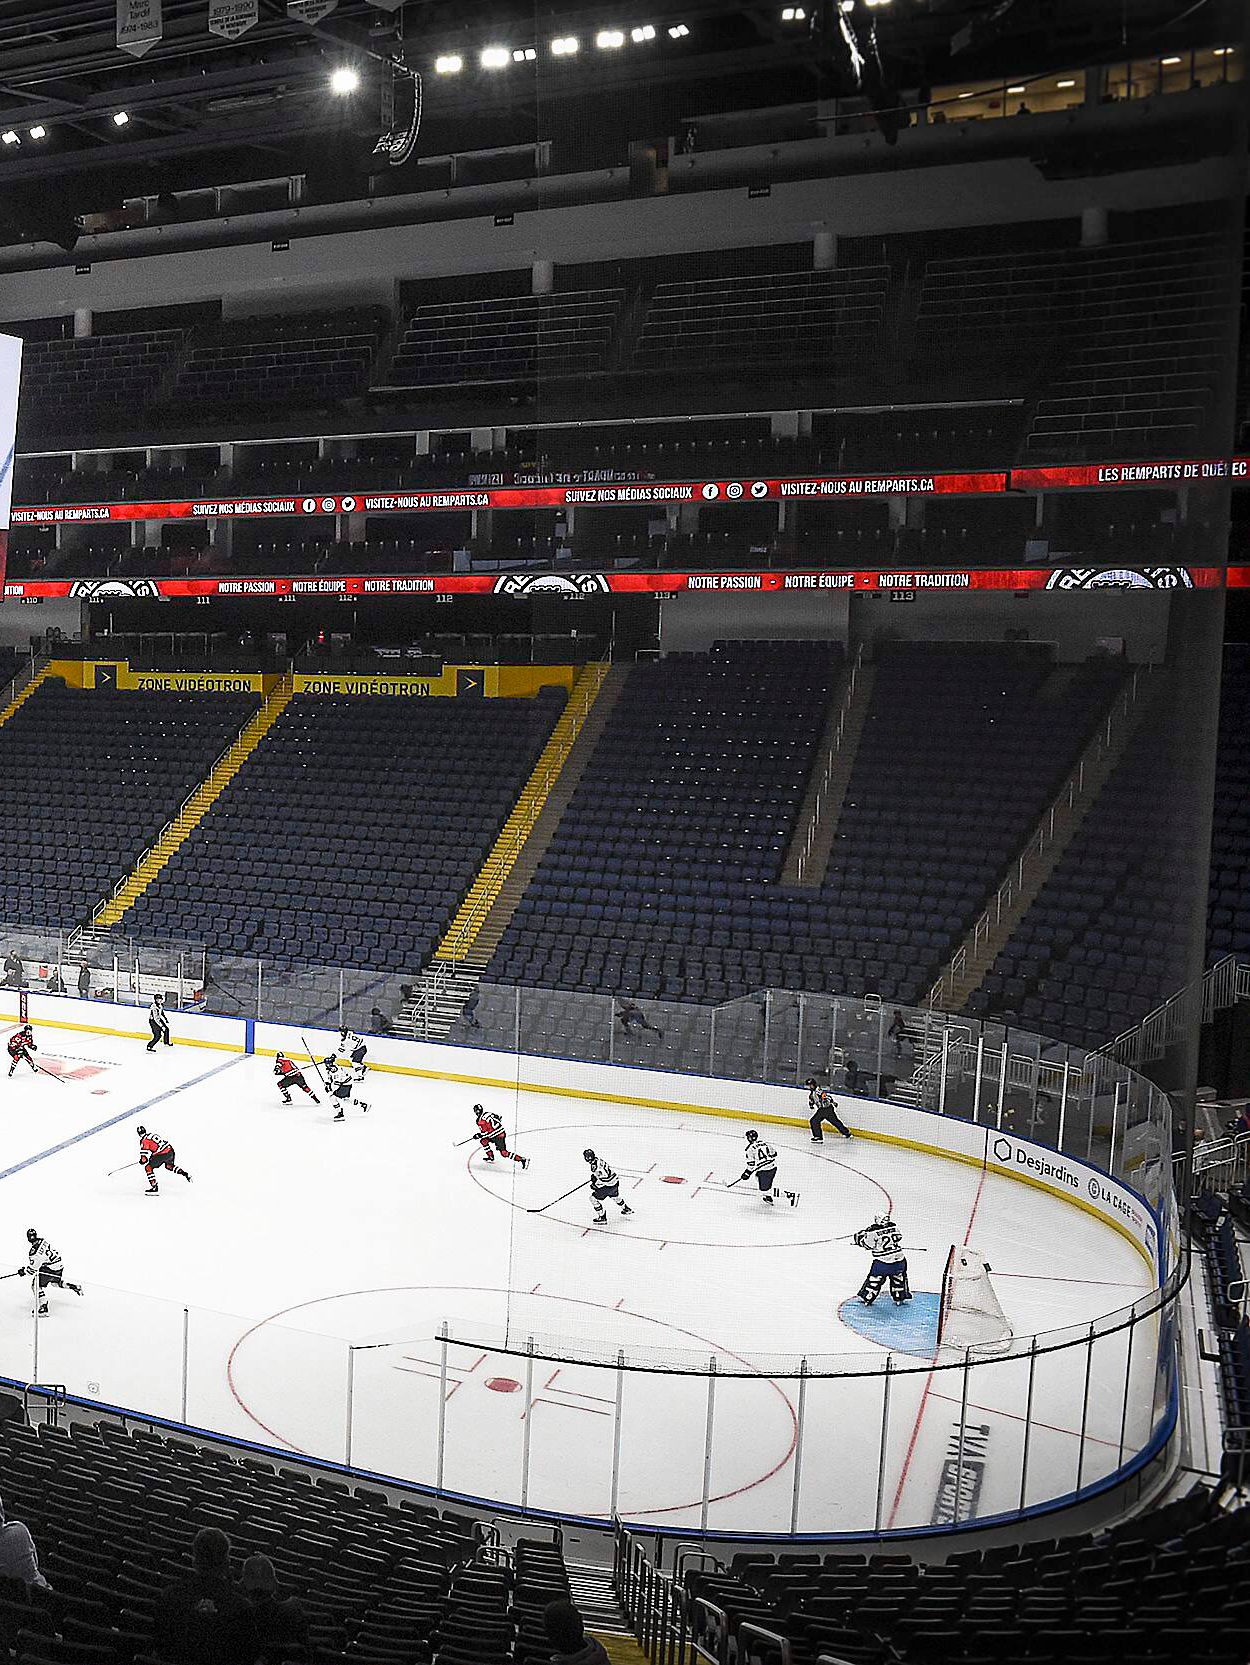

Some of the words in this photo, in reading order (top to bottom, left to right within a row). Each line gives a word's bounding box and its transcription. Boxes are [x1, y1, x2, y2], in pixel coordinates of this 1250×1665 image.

[1098, 468, 1119, 482] LES
[1121, 465, 1181, 481] REMPARTS
[1183, 464, 1199, 478] DE
[780, 481, 847, 495] VISITEZ-NOUS
[848, 480, 862, 493] AU
[864, 478, 934, 492] REMPARTS.CA
[565, 489, 597, 502] SUIVEZ
[597, 488, 616, 501] NOS
[617, 486, 651, 500] MÉDIAS
[652, 486, 692, 500] SOCIAUX
[192, 504, 218, 515] SUIVEZ
[218, 503, 233, 514] NOS
[234, 501, 262, 514] MÉDIAS
[262, 501, 295, 512] SOCIAUX
[365, 496, 419, 509] VISITEZ-NOUS
[420, 495, 432, 508] AU
[432, 494, 489, 507] REMPARTS.CA
[11, 509, 54, 521] VISITEZ-NOUS
[54, 509, 64, 520] AU
[64, 508, 110, 519] REMPARTS.CA
[218, 582, 243, 593] NOTRE
[243, 582, 275, 593] PASSION
[292, 581, 318, 592] NOTRE
[318, 579, 346, 592] ÉQUIPE
[364, 580, 391, 592] NOTRE
[391, 580, 434, 591] TRADITION
[687, 577, 719, 588] NOTRE
[720, 576, 761, 588] PASSION
[784, 575, 817, 588] NOTRE
[818, 573, 855, 588] ÉQUIPE
[878, 575, 913, 587] NOTRE
[914, 574, 969, 587] TRADITION
[196, 596, 210, 604] 111
[435, 594, 453, 603] 112
[892, 591, 914, 600] 113
[137, 678, 171, 691] ZONE
[175, 676, 251, 692] VIDÉOTRON
[303, 681, 341, 694] ZONE
[345, 678, 430, 696] VIDÉOTRON
[1015, 1148, 1080, 1188] Desjardins
[1101, 1188, 1111, 1204] LA
[1112, 1195, 1131, 1218] CAGE
[946, 1422, 991, 1458] TVA
